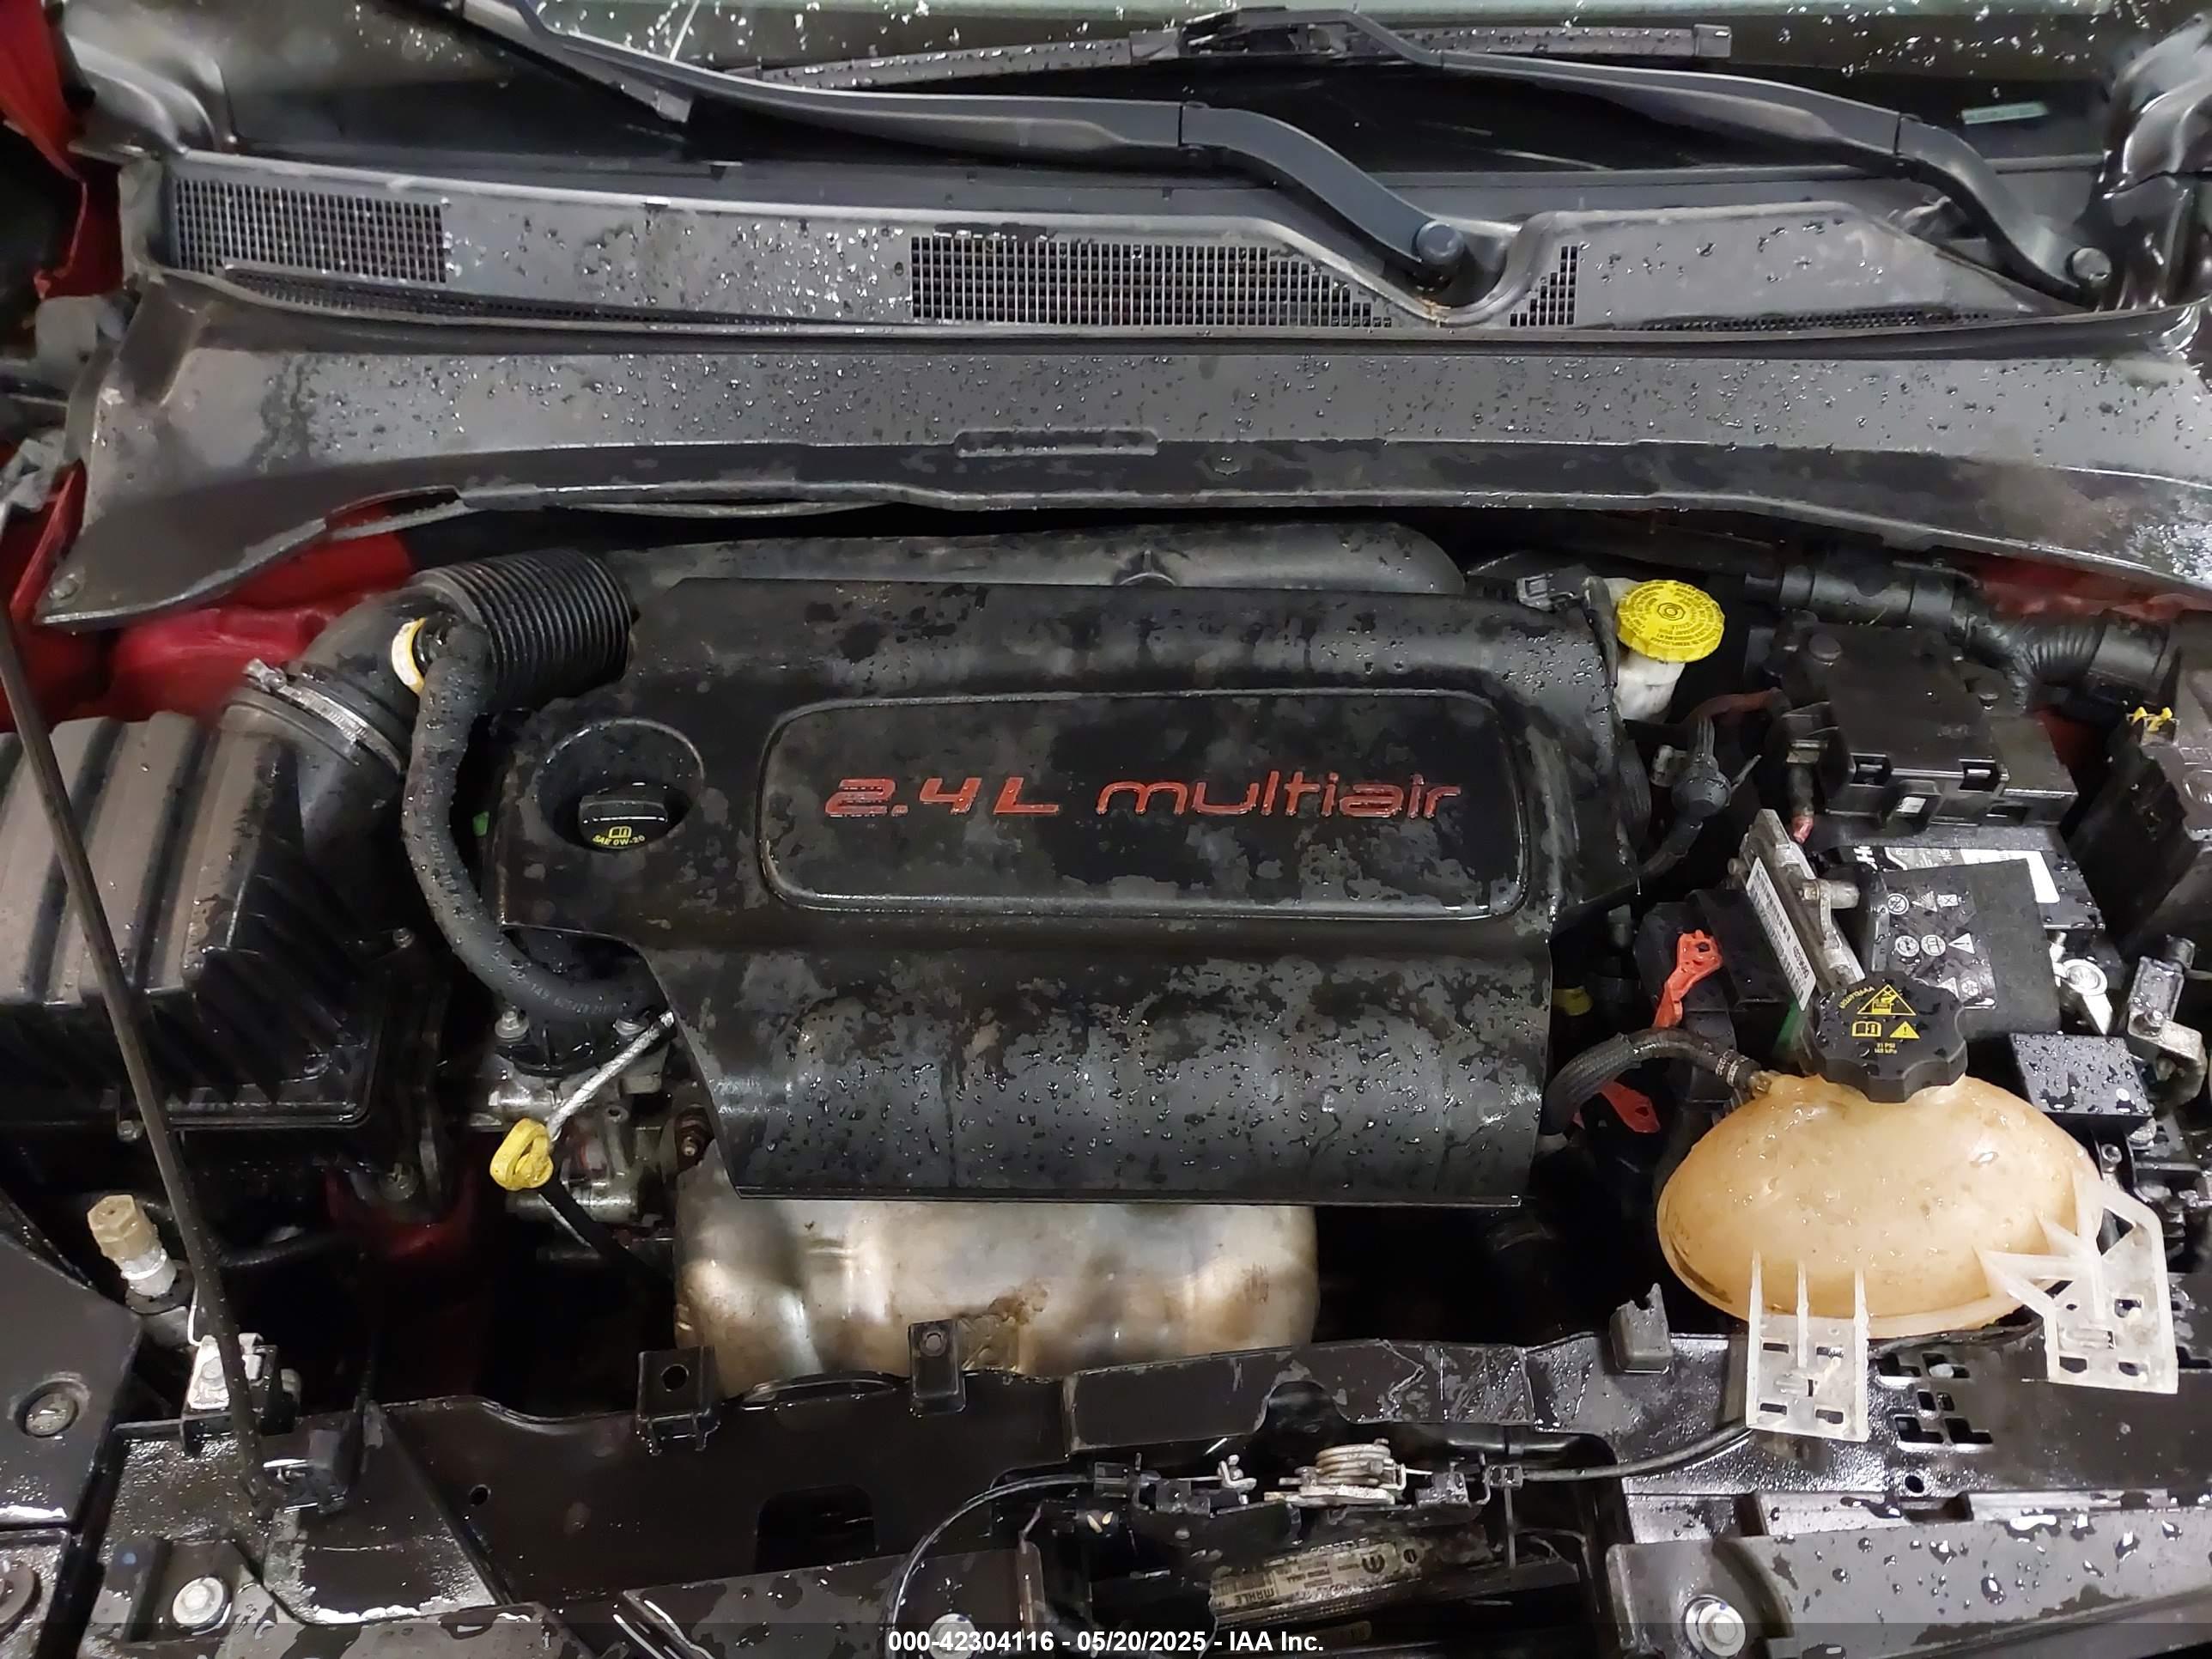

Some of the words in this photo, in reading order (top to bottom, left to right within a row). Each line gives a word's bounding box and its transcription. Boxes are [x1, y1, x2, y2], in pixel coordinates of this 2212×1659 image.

[824, 776, 1060, 817] 2.4L
[1096, 770, 1461, 817] multiair
[592, 834, 611, 846] SAE
[612, 834, 646, 846] 0W-20
